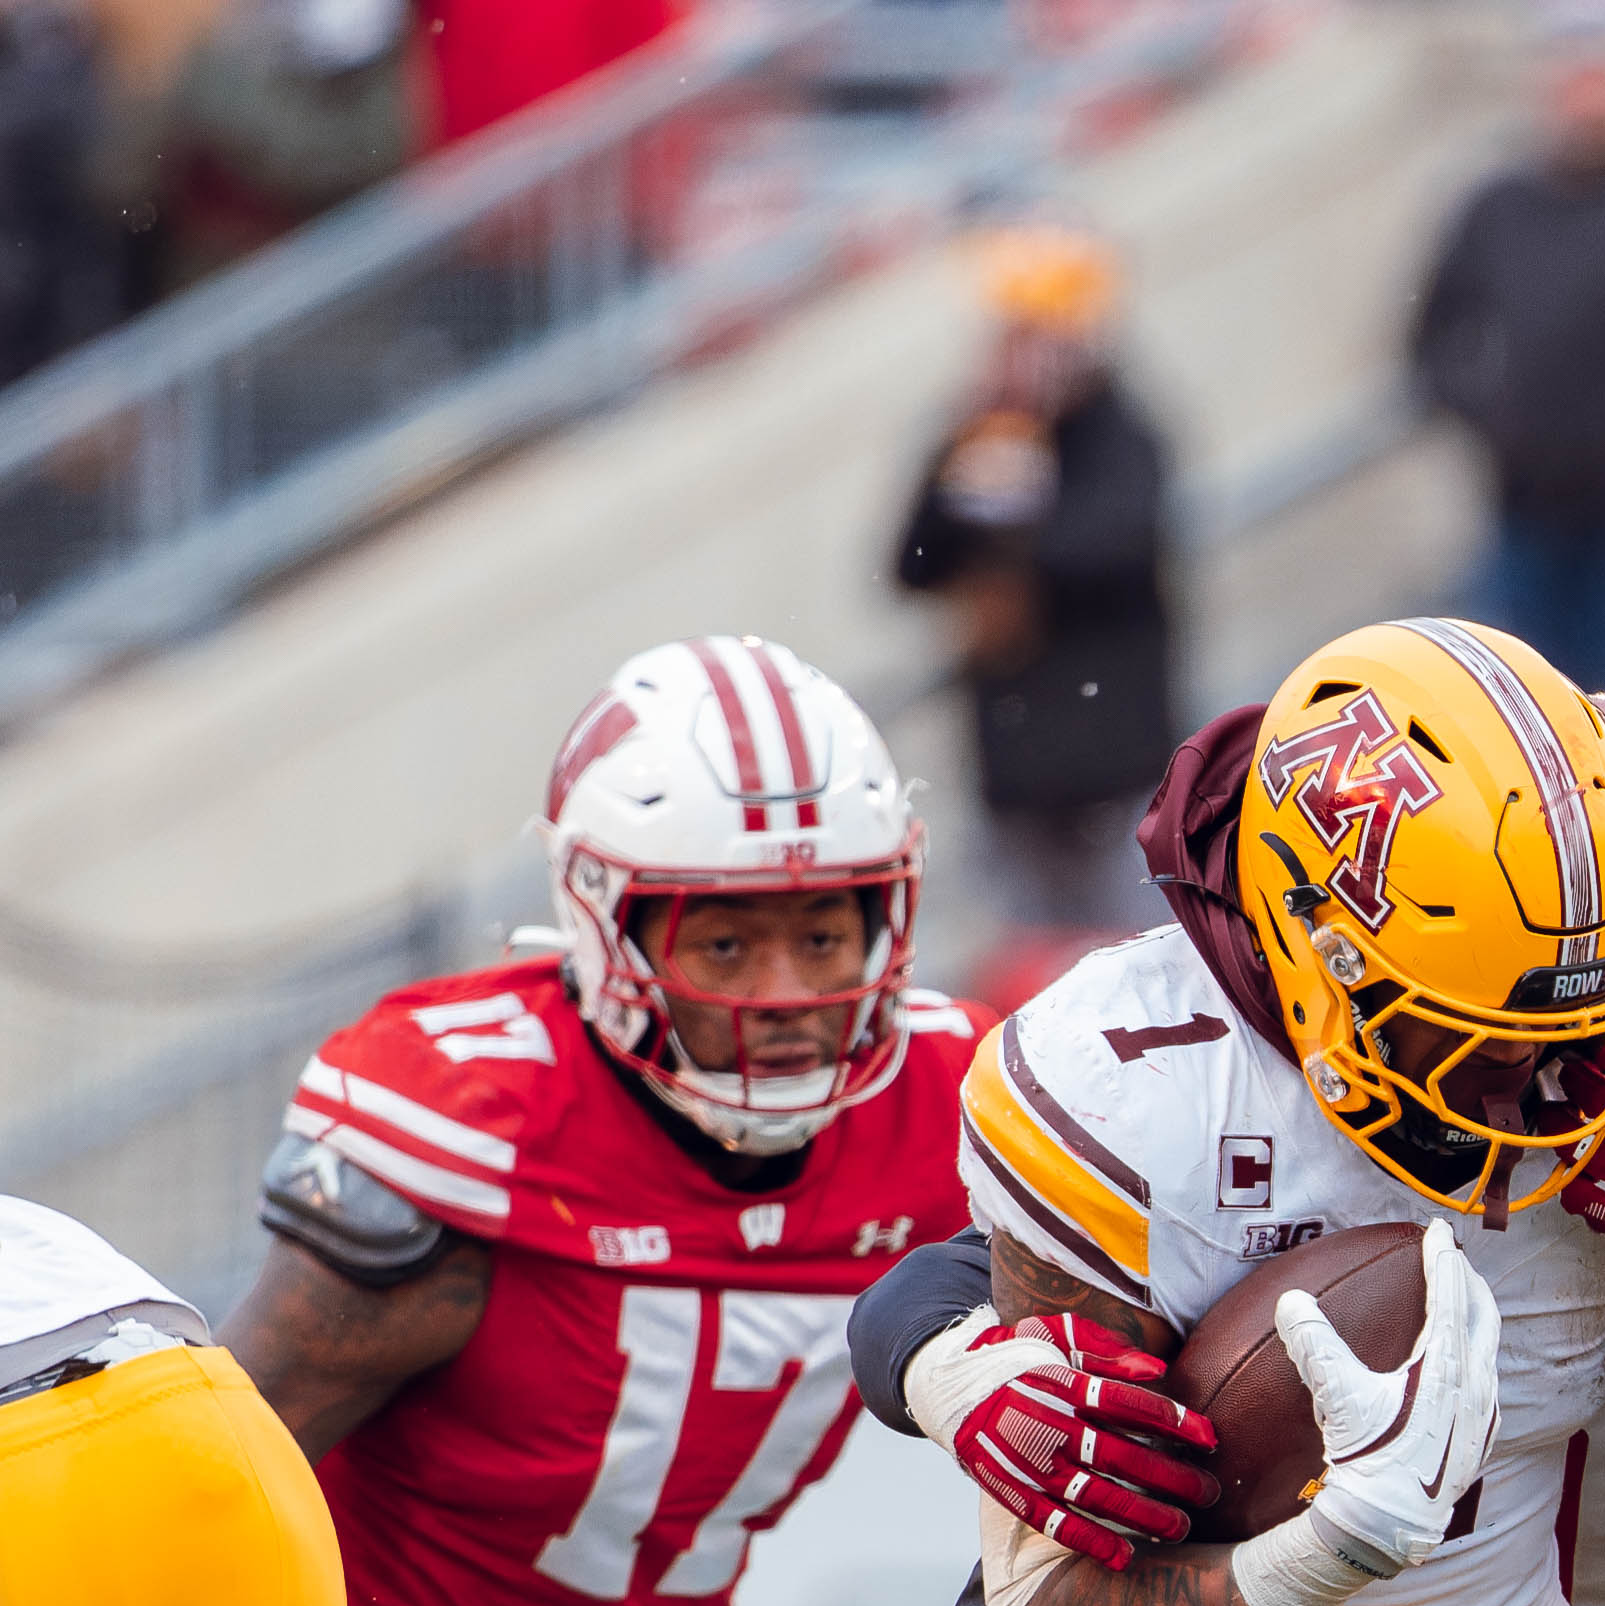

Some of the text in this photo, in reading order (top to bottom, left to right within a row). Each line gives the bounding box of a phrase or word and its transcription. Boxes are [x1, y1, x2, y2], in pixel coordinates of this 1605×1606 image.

[1552, 969, 1603, 999] ROW
[411, 991, 558, 1067] 17
[1100, 1011, 1231, 1064] 1
[1219, 1135, 1273, 1209] C
[532, 1285, 862, 1600] 17
